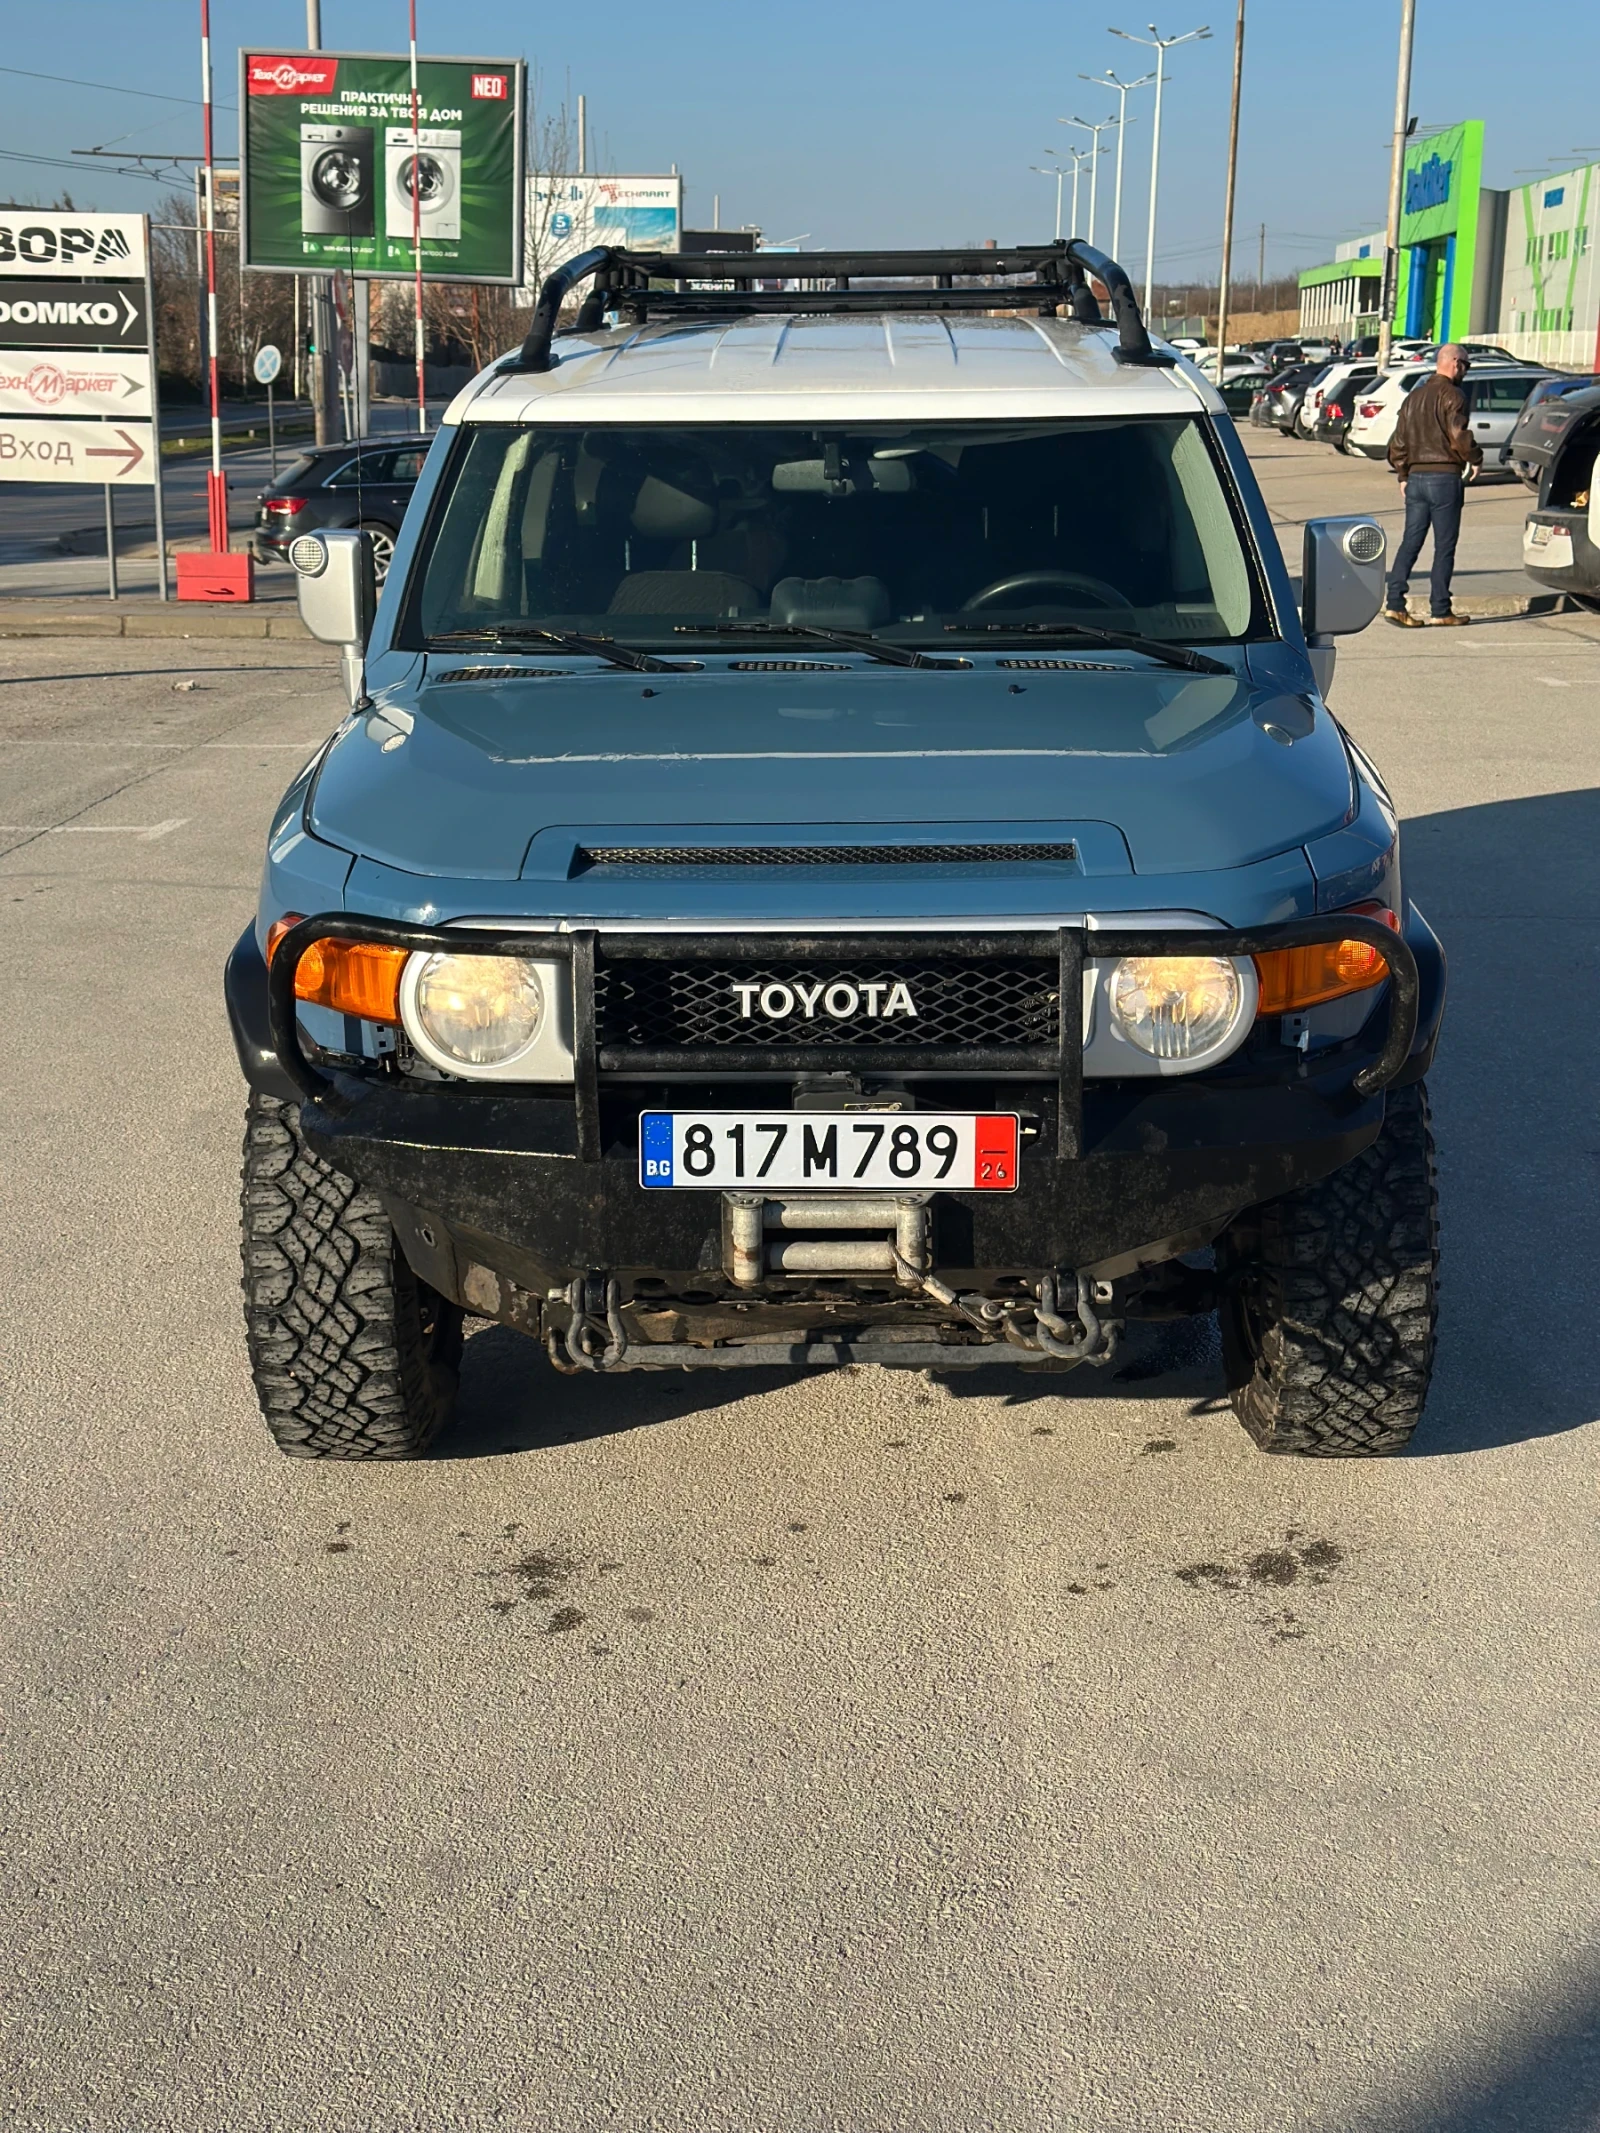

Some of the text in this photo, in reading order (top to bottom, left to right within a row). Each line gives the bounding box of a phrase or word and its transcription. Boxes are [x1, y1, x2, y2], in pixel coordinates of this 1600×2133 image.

[474, 76, 502, 97] NEO
[300, 103, 367, 116] РЕШЕНИЯ
[370, 107, 388, 118] ЗА
[429, 109, 462, 122] ДОМ
[555, 216, 566, 228] 5
[0, 434, 73, 466] Вход
[732, 982, 918, 1018] TOYOTA
[646, 1159, 671, 1176] BG
[980, 1162, 1008, 1179] 26
